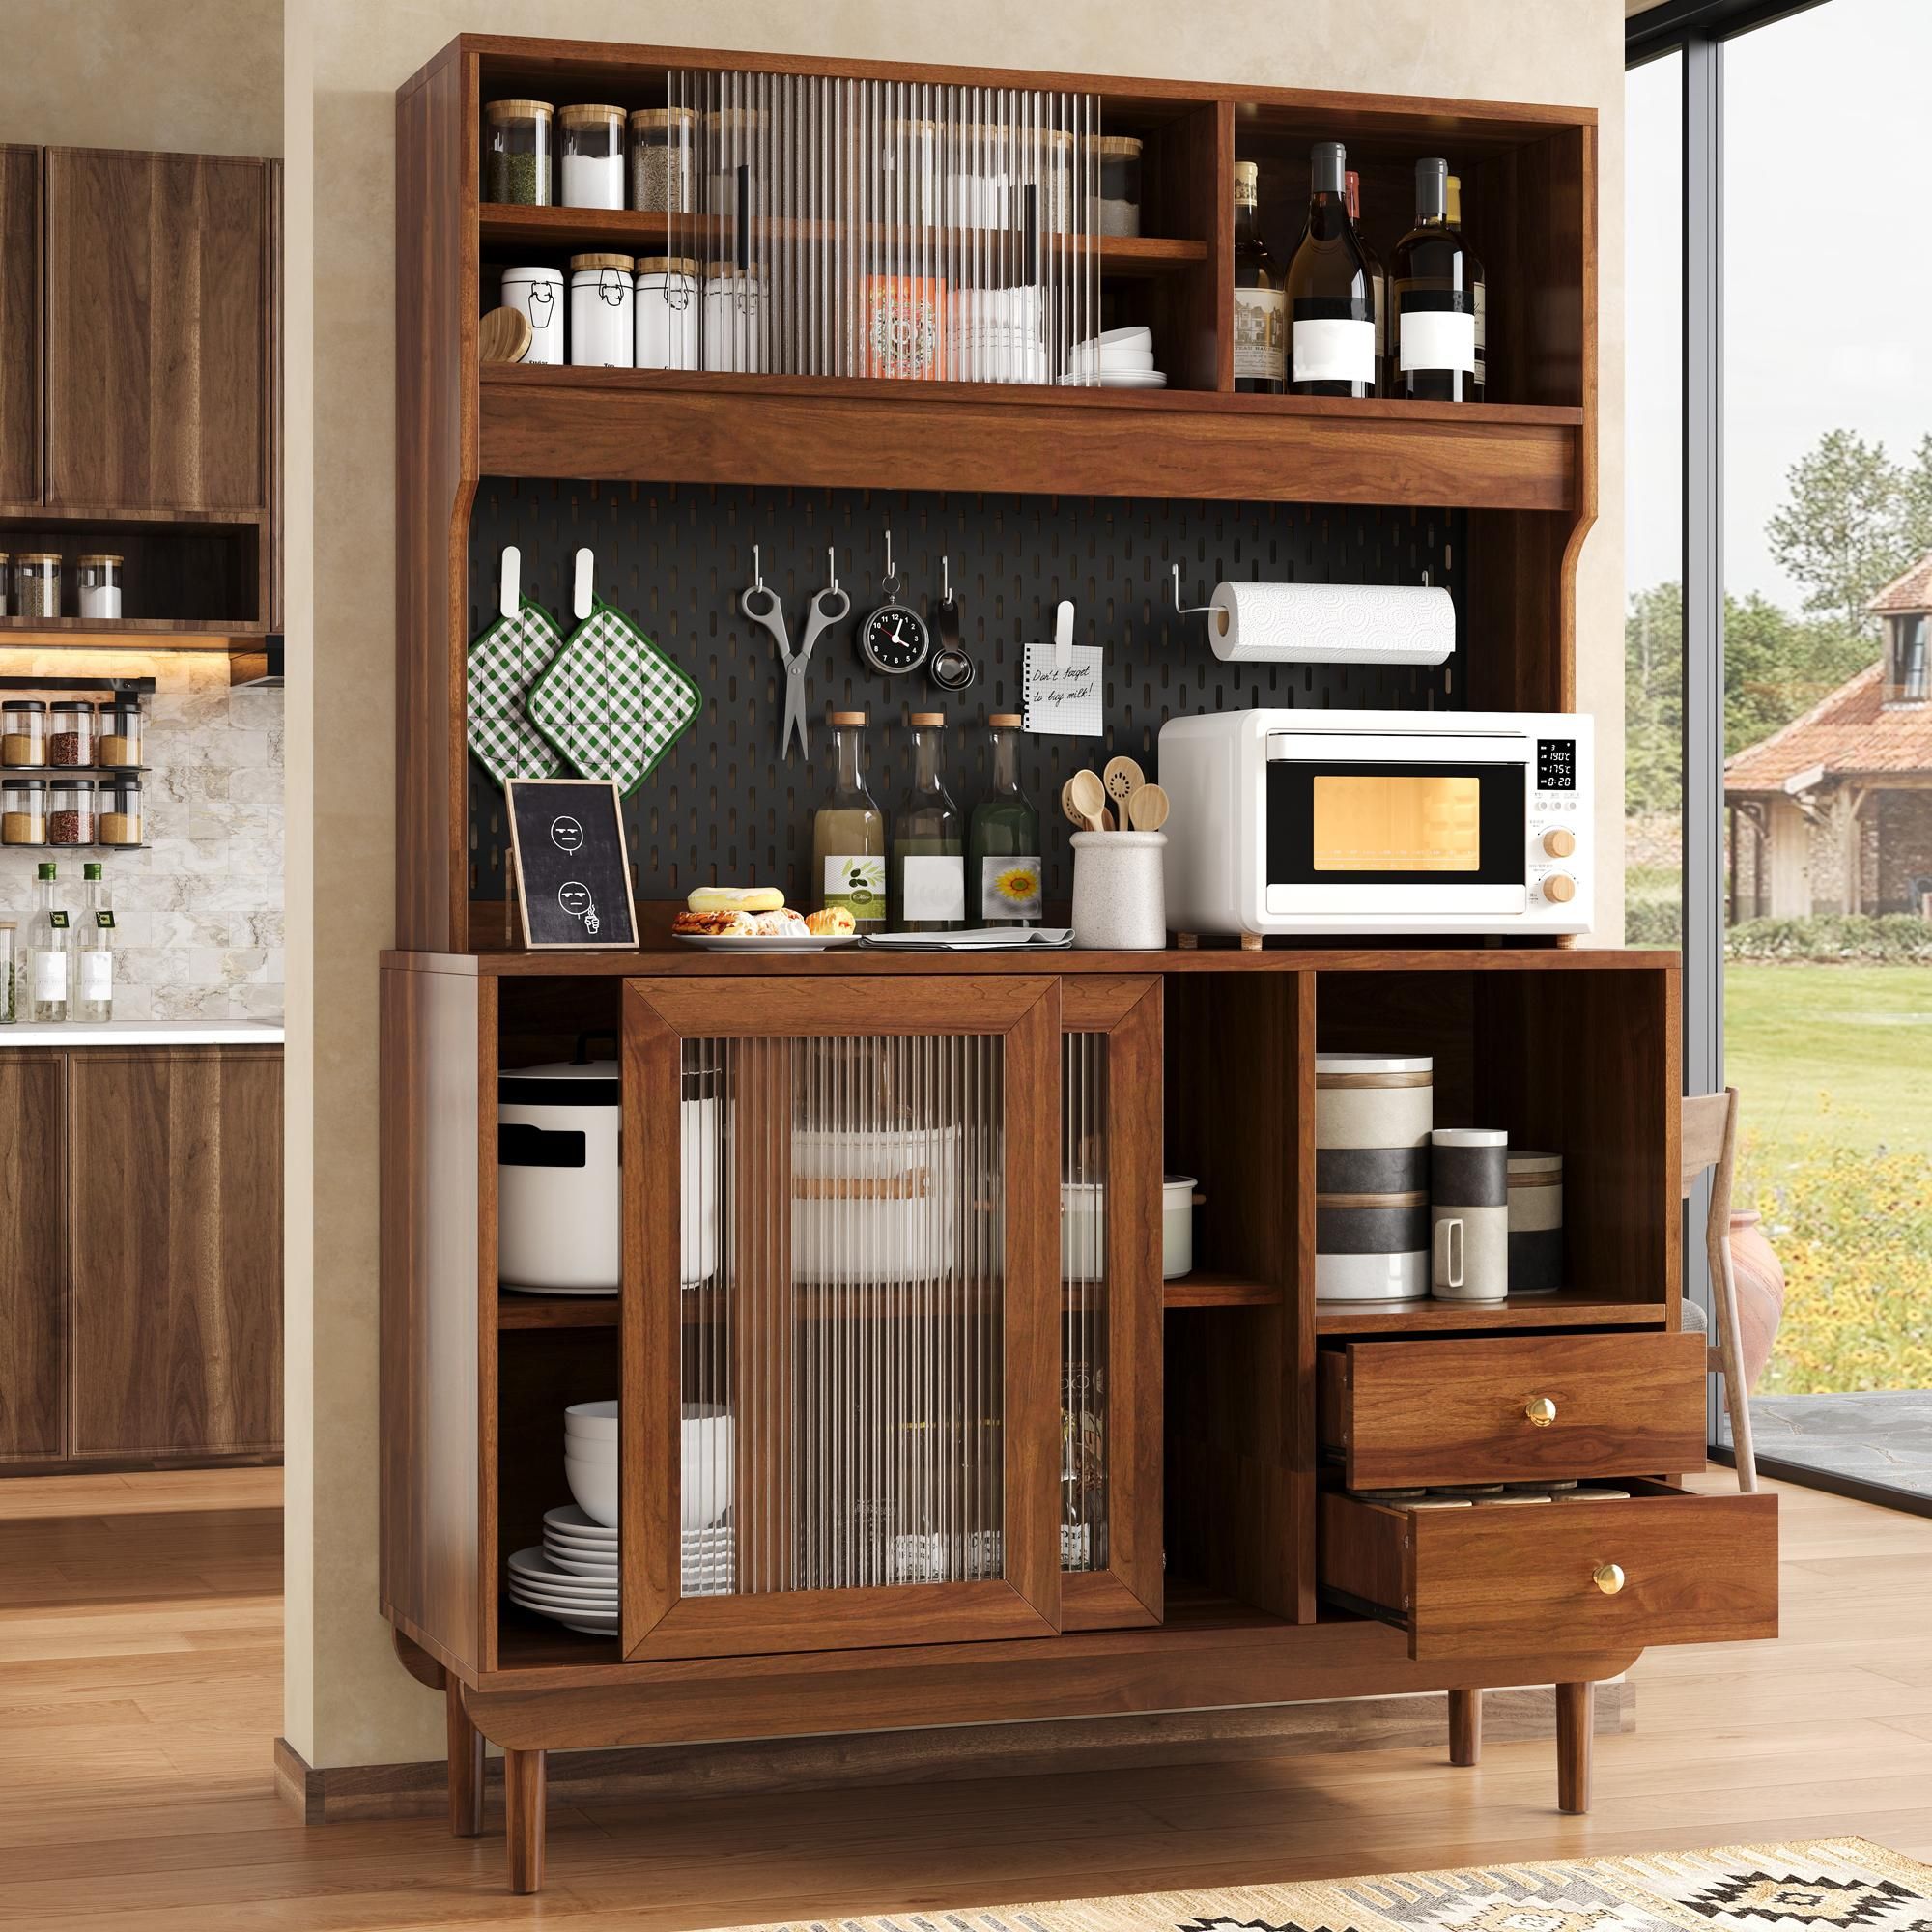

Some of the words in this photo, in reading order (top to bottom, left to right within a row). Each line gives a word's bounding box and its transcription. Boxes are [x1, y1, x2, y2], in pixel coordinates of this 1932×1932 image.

[1032, 669, 1059, 681] Don't
[1063, 665, 1090, 681] forget
[1033, 691, 1043, 702] to
[1047, 690, 1065, 707] buy
[1066, 682, 1094, 699] milk!
